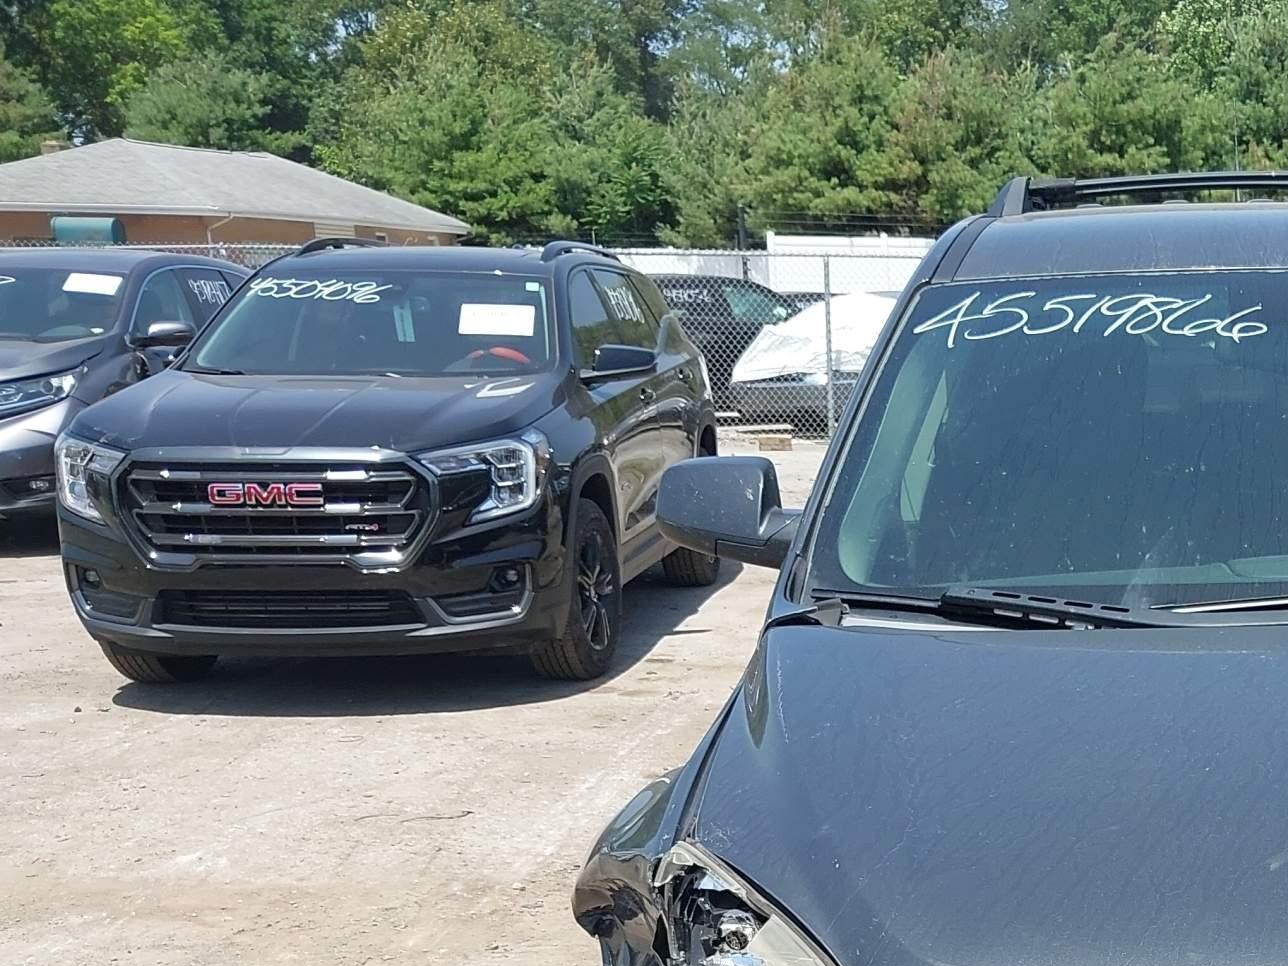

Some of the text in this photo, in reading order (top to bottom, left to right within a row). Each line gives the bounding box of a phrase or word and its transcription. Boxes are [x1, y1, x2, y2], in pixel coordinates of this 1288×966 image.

[246, 277, 393, 304] 45504096
[913, 291, 1268, 348] 45519866
[207, 483, 325, 505] GMC
